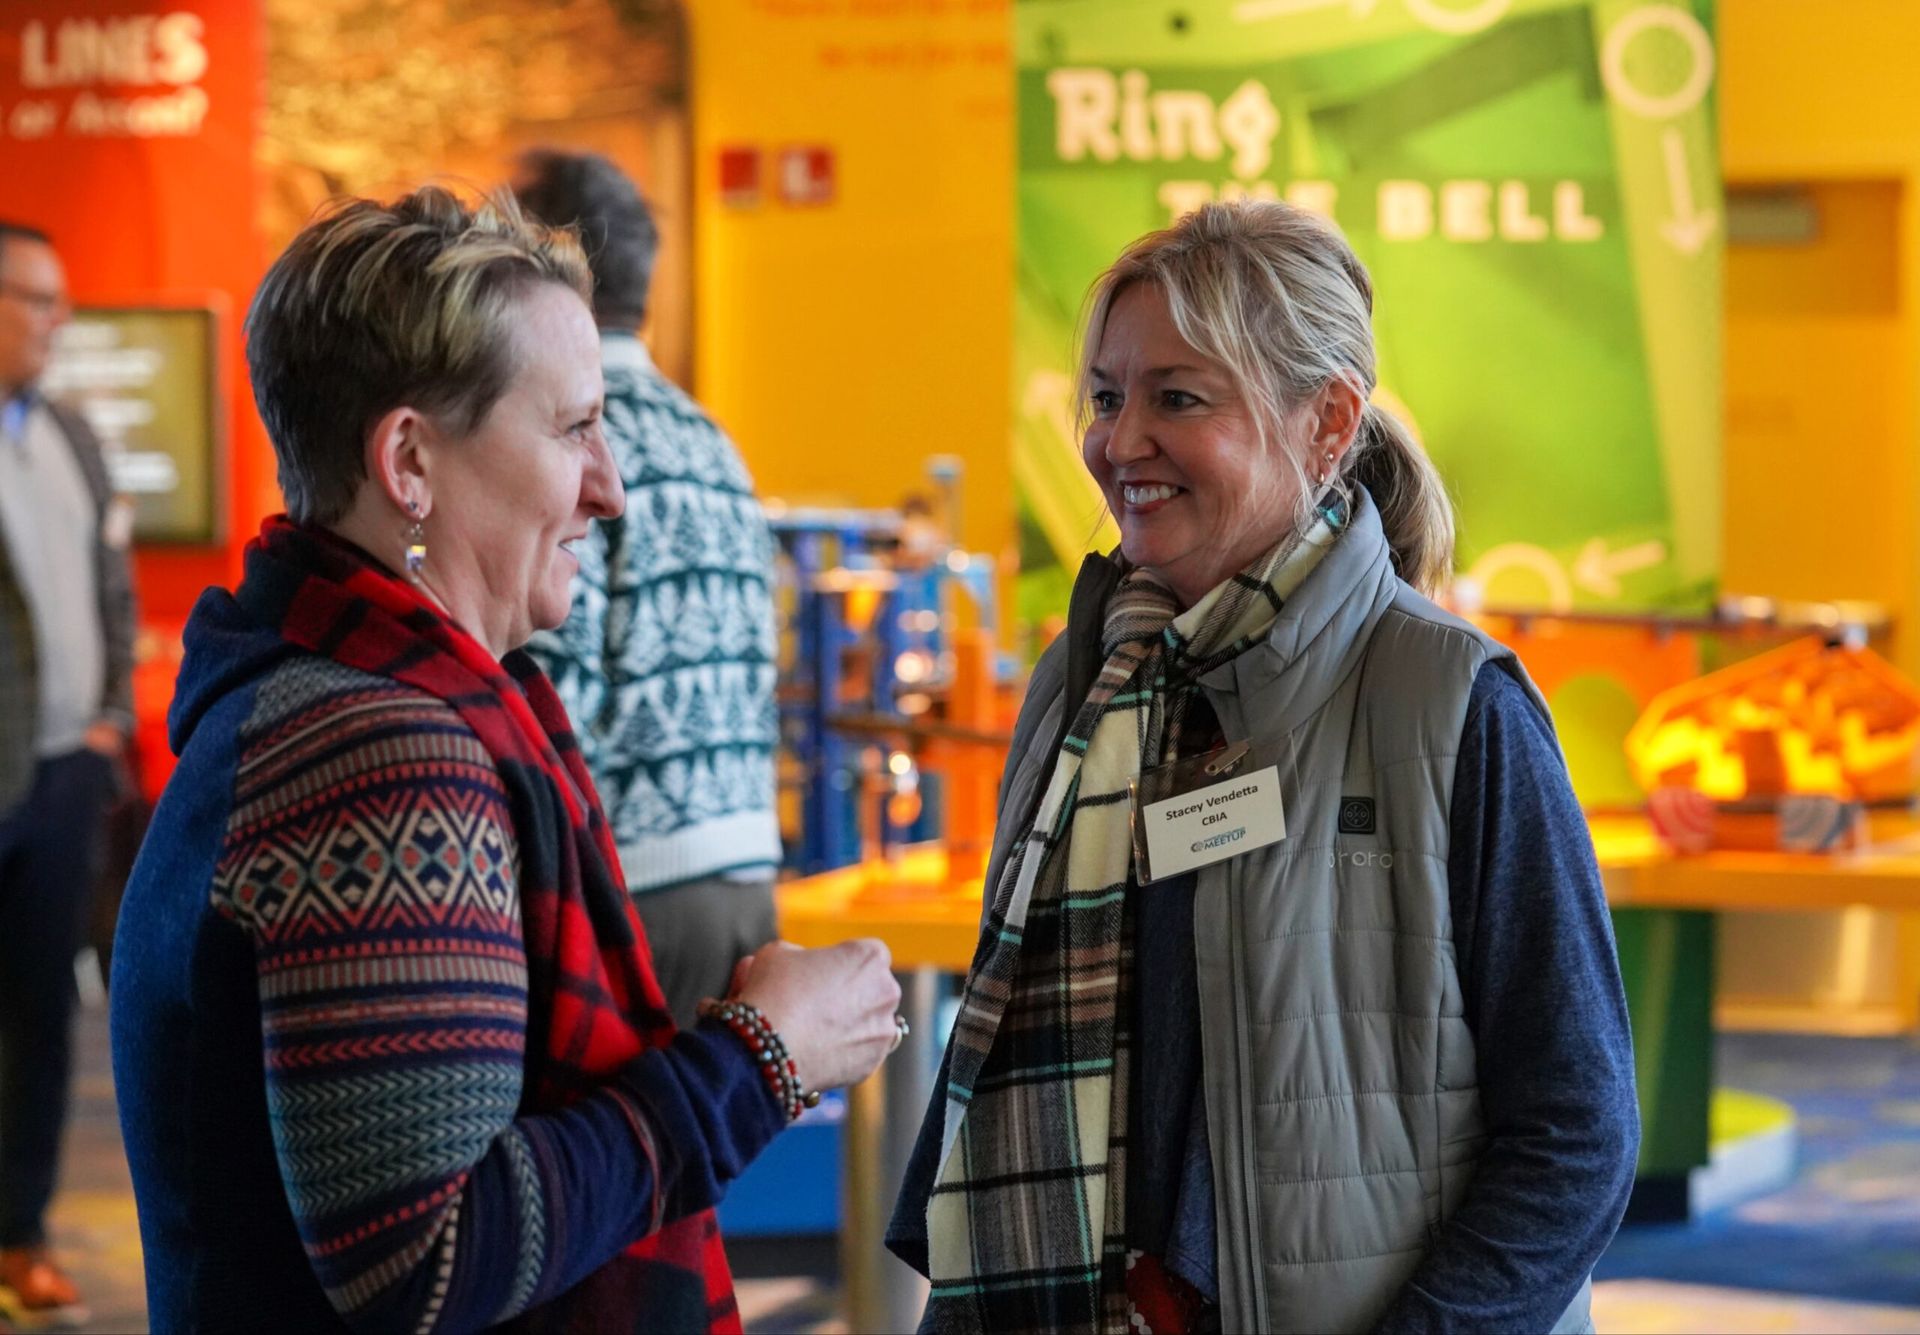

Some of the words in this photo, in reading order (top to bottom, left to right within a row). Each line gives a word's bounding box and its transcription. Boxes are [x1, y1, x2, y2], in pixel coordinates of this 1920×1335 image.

[20, 12, 208, 88] LINES
[1046, 67, 1280, 181] Ring
[1377, 179, 1604, 243] BELL
[1165, 803, 1204, 821] Stacey
[1206, 784, 1259, 811] Vendetta
[1201, 812, 1228, 826] CBIA
[1203, 829, 1246, 850] MEETUP
